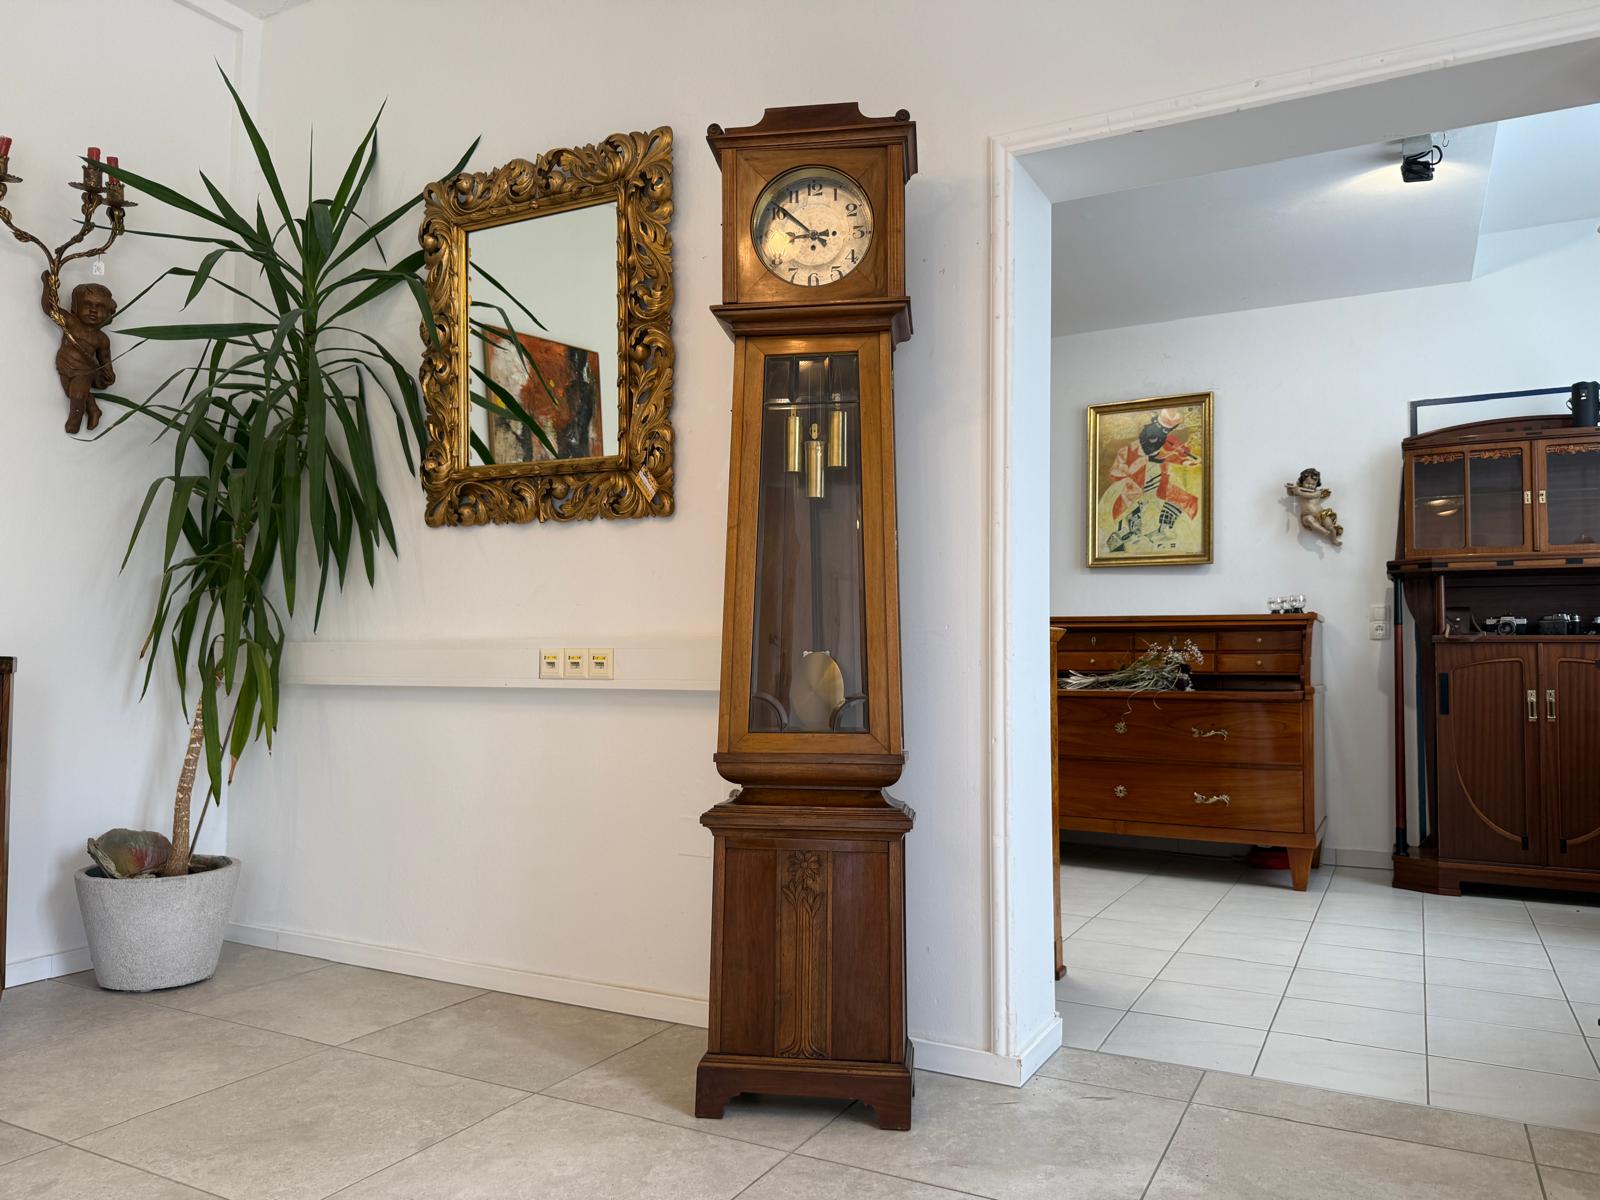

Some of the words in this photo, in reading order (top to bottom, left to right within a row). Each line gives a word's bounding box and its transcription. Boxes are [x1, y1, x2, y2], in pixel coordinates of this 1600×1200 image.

[789, 190, 799, 203] 11
[808, 183, 823, 196] 12
[833, 188, 838, 201] 1
[771, 206, 787, 220] 10
[845, 203, 858, 217] 2
[852, 225, 865, 239] 3
[845, 249, 859, 264] 4
[788, 267, 798, 284] 7
[807, 273, 819, 287] 6
[830, 266, 843, 281] 5
